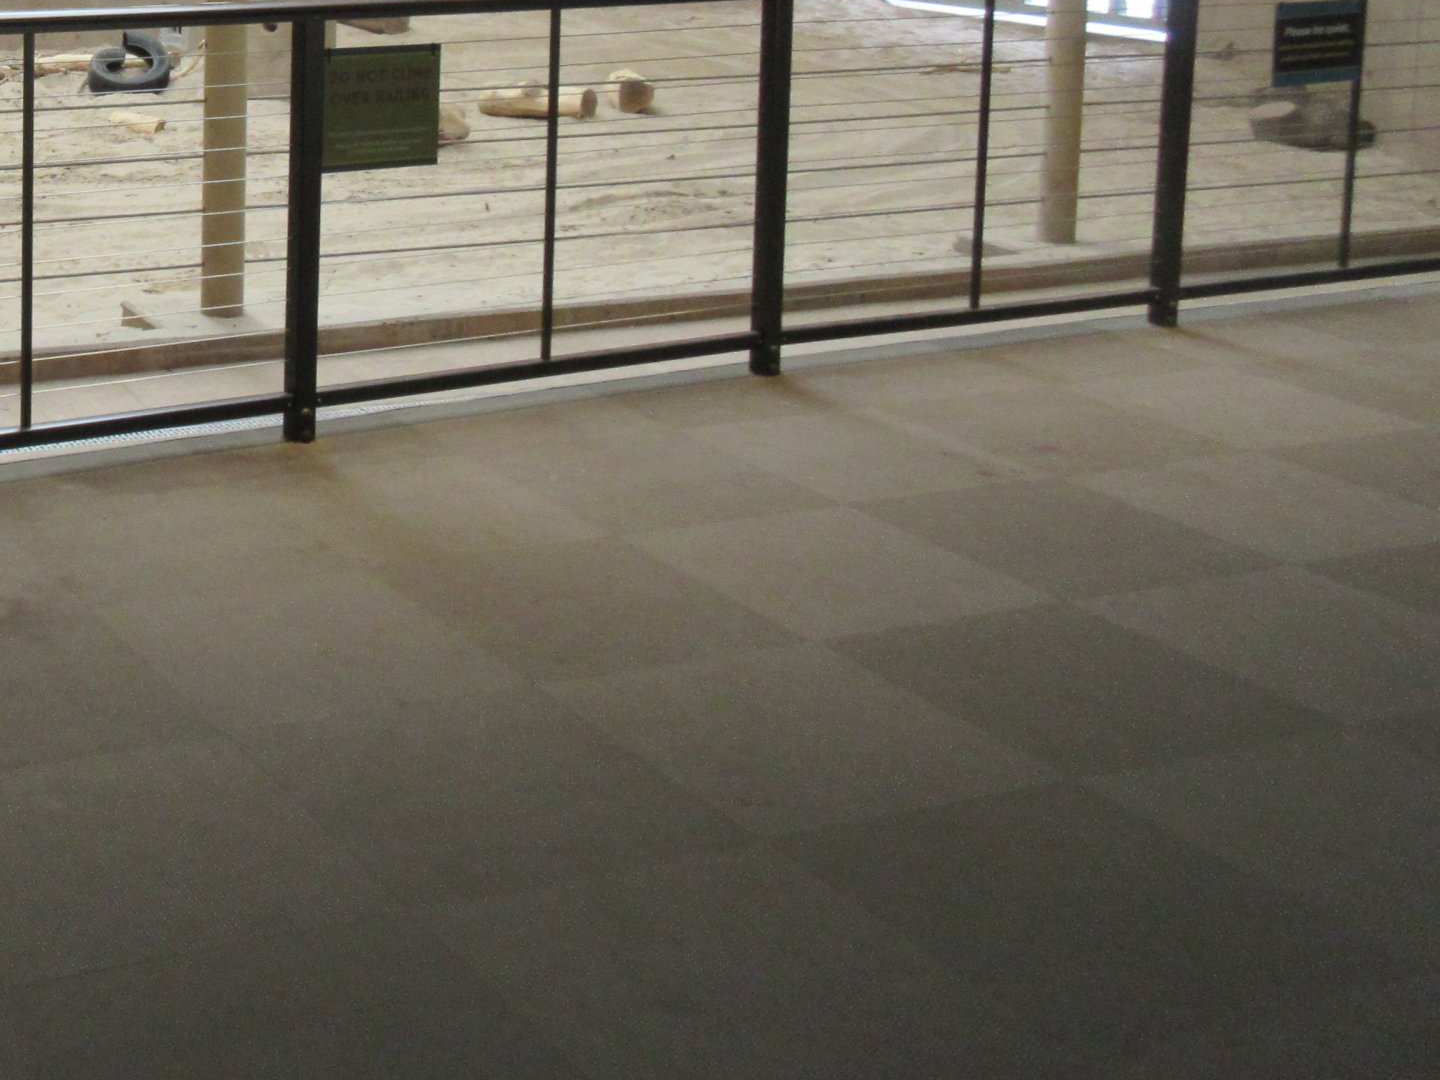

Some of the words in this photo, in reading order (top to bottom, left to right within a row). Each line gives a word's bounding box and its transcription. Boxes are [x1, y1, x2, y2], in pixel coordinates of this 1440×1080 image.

[328, 70, 351, 85] DO
[356, 68, 386, 83] NOT
[391, 66, 432, 81] CLIMB
[330, 90, 370, 105] OVER
[375, 87, 430, 104] RAILING
